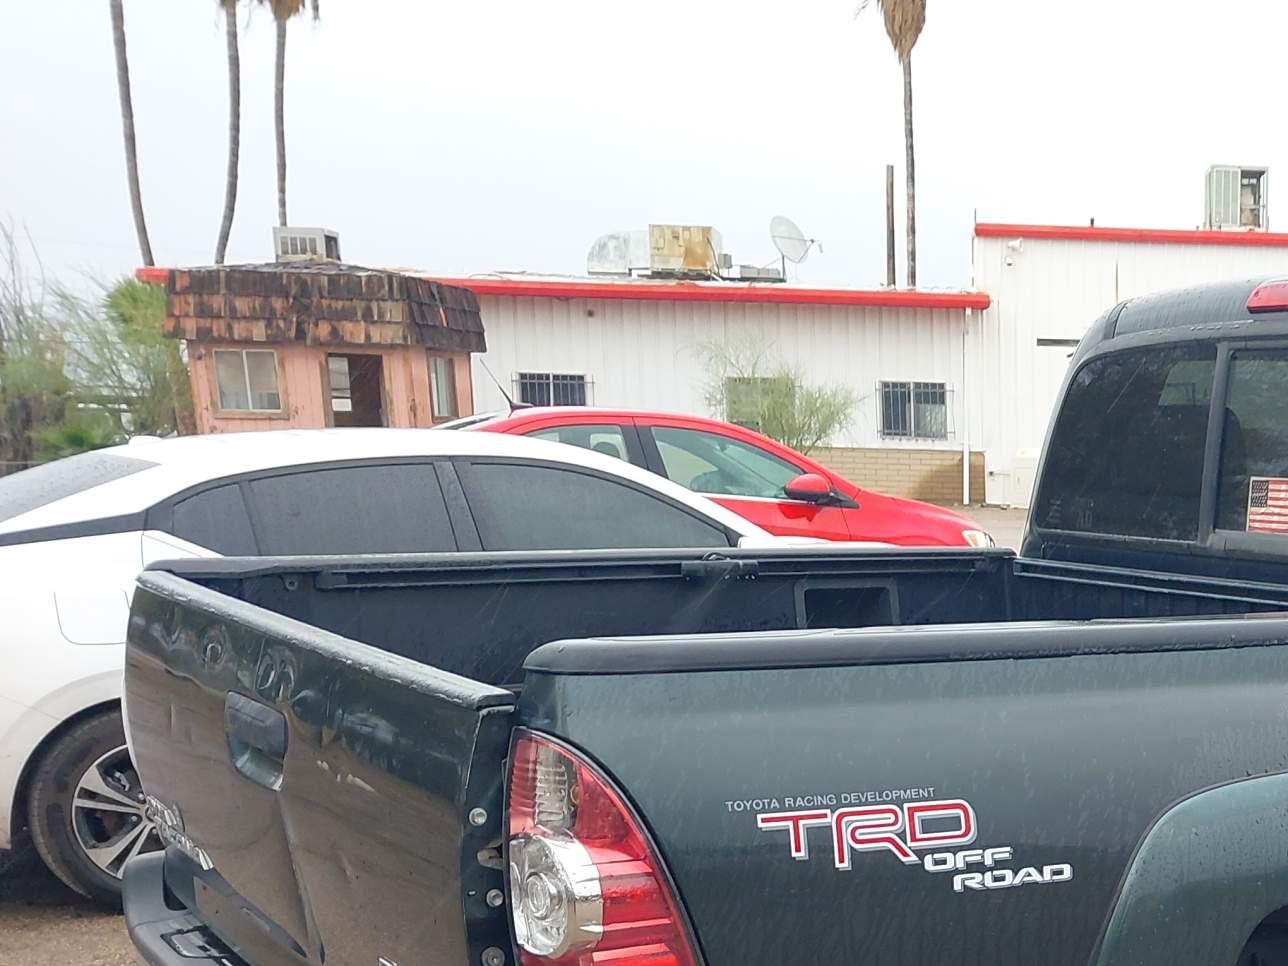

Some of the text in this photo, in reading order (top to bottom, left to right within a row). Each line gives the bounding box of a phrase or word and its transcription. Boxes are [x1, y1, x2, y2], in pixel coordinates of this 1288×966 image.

[725, 787, 936, 813] TOYOTA RACING DEVELOPMENT
[757, 799, 977, 871] TRD
[923, 846, 1013, 872] OFF
[953, 863, 1074, 893] ROAD
